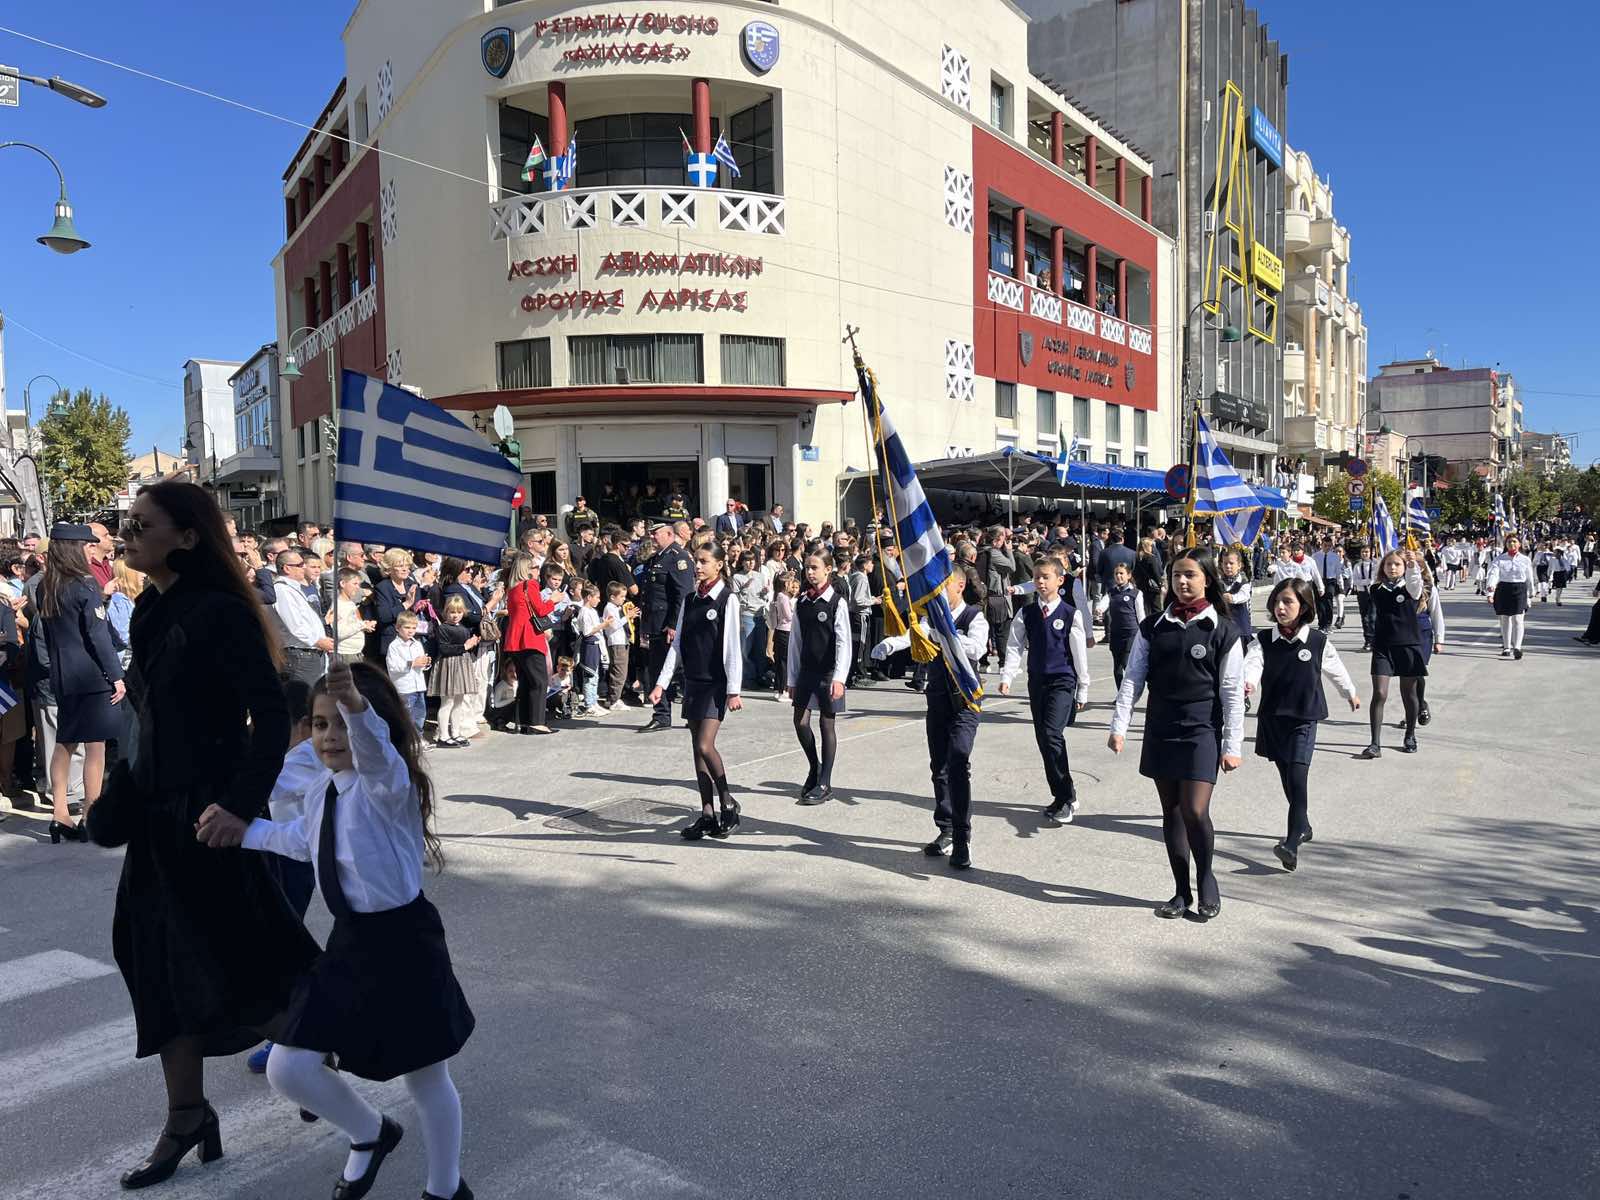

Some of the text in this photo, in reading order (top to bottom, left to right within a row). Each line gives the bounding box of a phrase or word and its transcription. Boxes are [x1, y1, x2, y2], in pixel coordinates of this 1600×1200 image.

[508, 253, 578, 281] ΛΕΣΧΗ
[521, 287, 748, 313] ΦΡΟΥΡΑΣ ΛΑΡΙΣΑΣ
